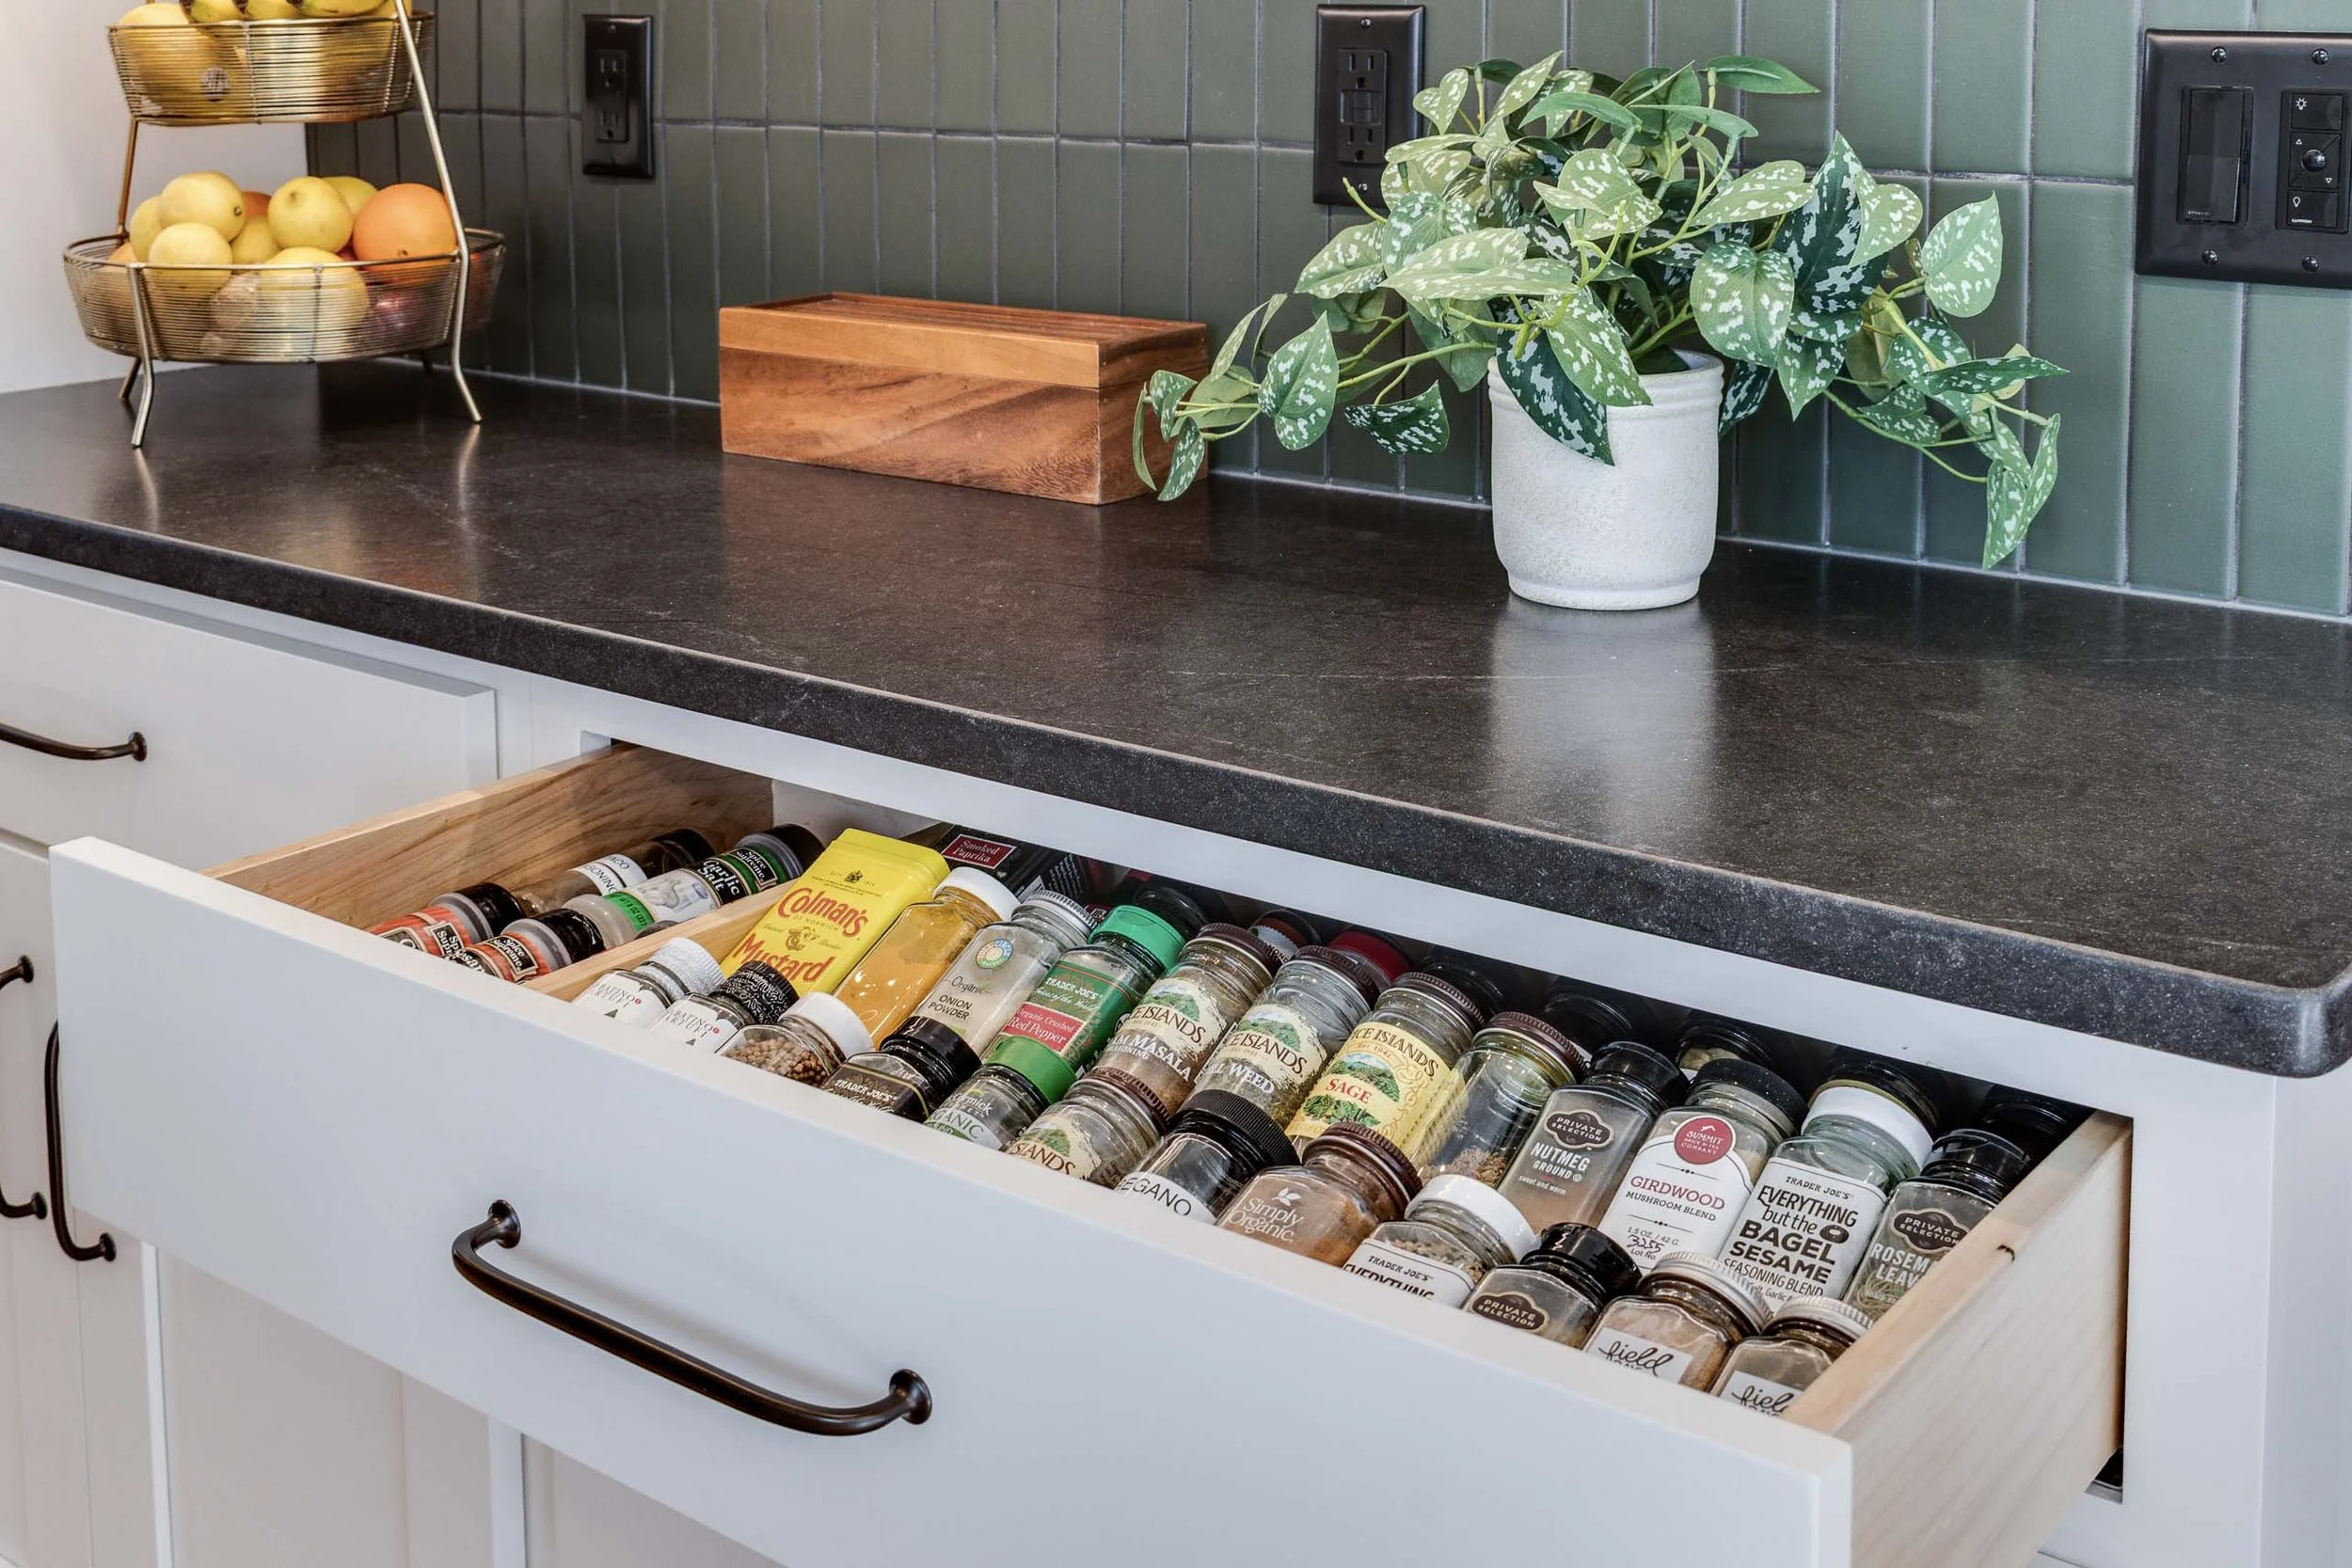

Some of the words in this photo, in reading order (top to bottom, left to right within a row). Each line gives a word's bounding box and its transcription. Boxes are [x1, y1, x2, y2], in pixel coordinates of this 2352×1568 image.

[747, 850, 766, 870] Spice
[952, 847, 991, 862] Paprika
[961, 840, 1000, 855] Smoked
[611, 856, 629, 870] ACO
[697, 866, 723, 892] Salt
[703, 860, 740, 895] Garlic
[778, 887, 868, 938] Colman's
[504, 938, 525, 958] Spice
[732, 933, 836, 982] Mustard
[951, 975, 985, 994] Organic
[1045, 977, 1076, 992] TRADER
[1074, 988, 1099, 1000] JOE'S
[929, 1002, 970, 1020] POWDER
[939, 994, 973, 1010] ONION
[1009, 1017, 1029, 1031] Red
[1028, 1024, 1066, 1044] Pepper
[1044, 1017, 1074, 1033] Crushed
[1142, 1006, 1206, 1044] ISLANDS
[1131, 1034, 1192, 1082] MASALA
[1240, 1033, 1308, 1075] ISLANDS
[1374, 1029, 1439, 1078] ISLANDS
[834, 1080, 869, 1095] TRADER
[867, 1087, 893, 1102] JOE'S
[1229, 1063, 1275, 1094] WEED
[1326, 1078, 1373, 1104] SAGE
[934, 1108, 985, 1140] GANIC
[1550, 1122, 1602, 1142] SELECTION
[1556, 1117, 1603, 1136] PRIVATE
[1680, 1142, 1718, 1155] COMPANY
[1686, 1131, 1724, 1145] SUMMIT
[1012, 1141, 1077, 1175] SLANDS
[1530, 1142, 1591, 1173] NUTMEG
[1533, 1160, 1573, 1179] GROUND
[1120, 1177, 1192, 1216] EGANO
[1630, 1176, 1725, 1211] GIRDWOOD
[1786, 1176, 1822, 1193] TRADER
[1823, 1187, 1851, 1200] JOE'S
[1242, 1196, 1305, 1228] Simply
[1626, 1191, 1683, 1212] MUSHROOM
[1682, 1205, 1717, 1222] BLEND
[1756, 1184, 1859, 1227] EVERYTHING
[1228, 1210, 1295, 1243] Organic
[1762, 1204, 1792, 1227] but
[1791, 1215, 1818, 1235] the
[1903, 1216, 1961, 1238] PRIVATE
[1739, 1219, 1836, 1266] BAGEL
[1899, 1224, 1960, 1244] SELECTION
[1630, 1248, 1644, 1257] Lot
[1729, 1241, 1832, 1285] SESAME
[1870, 1243, 1931, 1274] ROSEM
[1367, 1256, 1404, 1273] TRADER
[1404, 1269, 1430, 1281] JOE'S
[1724, 1258, 1787, 1289] SEASONING
[1785, 1277, 1824, 1296] BLEND
[1875, 1263, 1920, 1289] LEAV
[1477, 1305, 1535, 1327] SELECTION
[1484, 1299, 1537, 1321] PRIVATE
[1598, 1340, 1675, 1377] field
[1731, 1385, 1795, 1413] fiel
